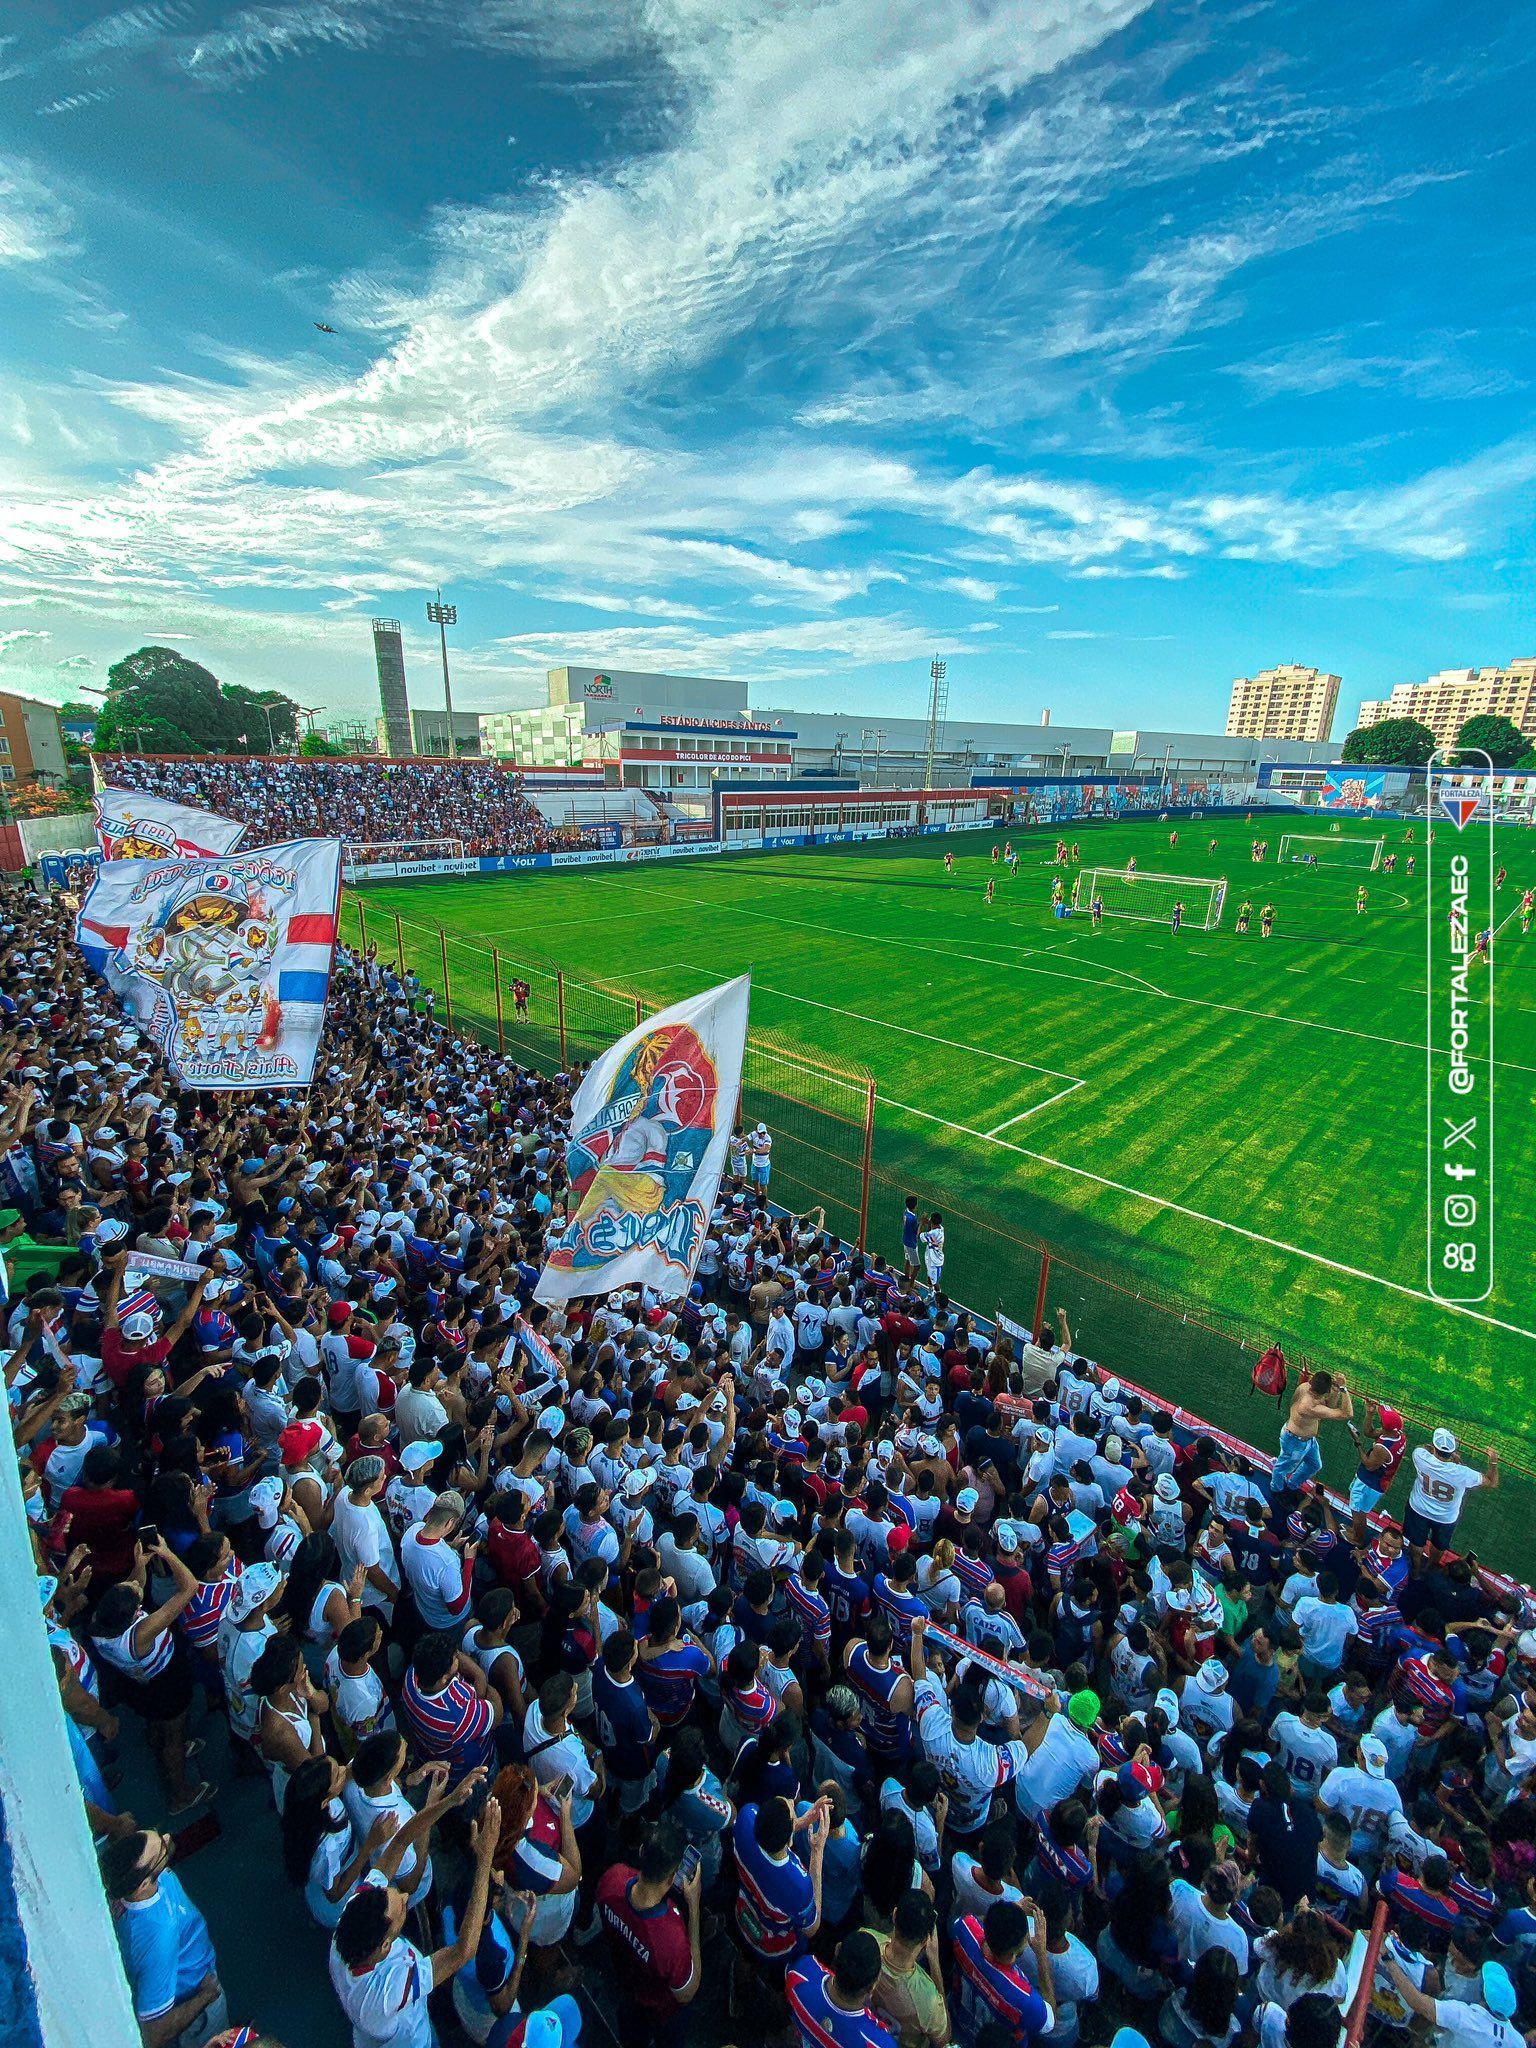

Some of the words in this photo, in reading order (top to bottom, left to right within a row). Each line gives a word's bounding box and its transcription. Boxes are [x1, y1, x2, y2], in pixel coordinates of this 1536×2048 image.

[584, 684, 613, 695] NORTH
[660, 714, 700, 727] ESTÁDIO
[701, 719, 737, 730] ALCIDES
[739, 720, 771, 731] SANTOS
[676, 752, 708, 760] TRICOLOR
[672, 846, 694, 854] novibet
[698, 844, 719, 853] novibet
[512, 858, 537, 867] VOLT
[554, 856, 580, 864] novibet
[587, 853, 612, 861] novibet
[401, 864, 435, 874] novibet
[1062, 1386, 1083, 1411] 18
[1421, 1472, 1456, 1503] 18
[1113, 1493, 1124, 1513] 18
[1241, 1550, 1259, 1571] 18
[830, 1591, 849, 1622] 18
[973, 1617, 1002, 1634] CAIXA
[1286, 1749, 1315, 1780] 18
[1351, 1805, 1388, 1833] 18
[604, 1904, 651, 1963] FORTALEZA
